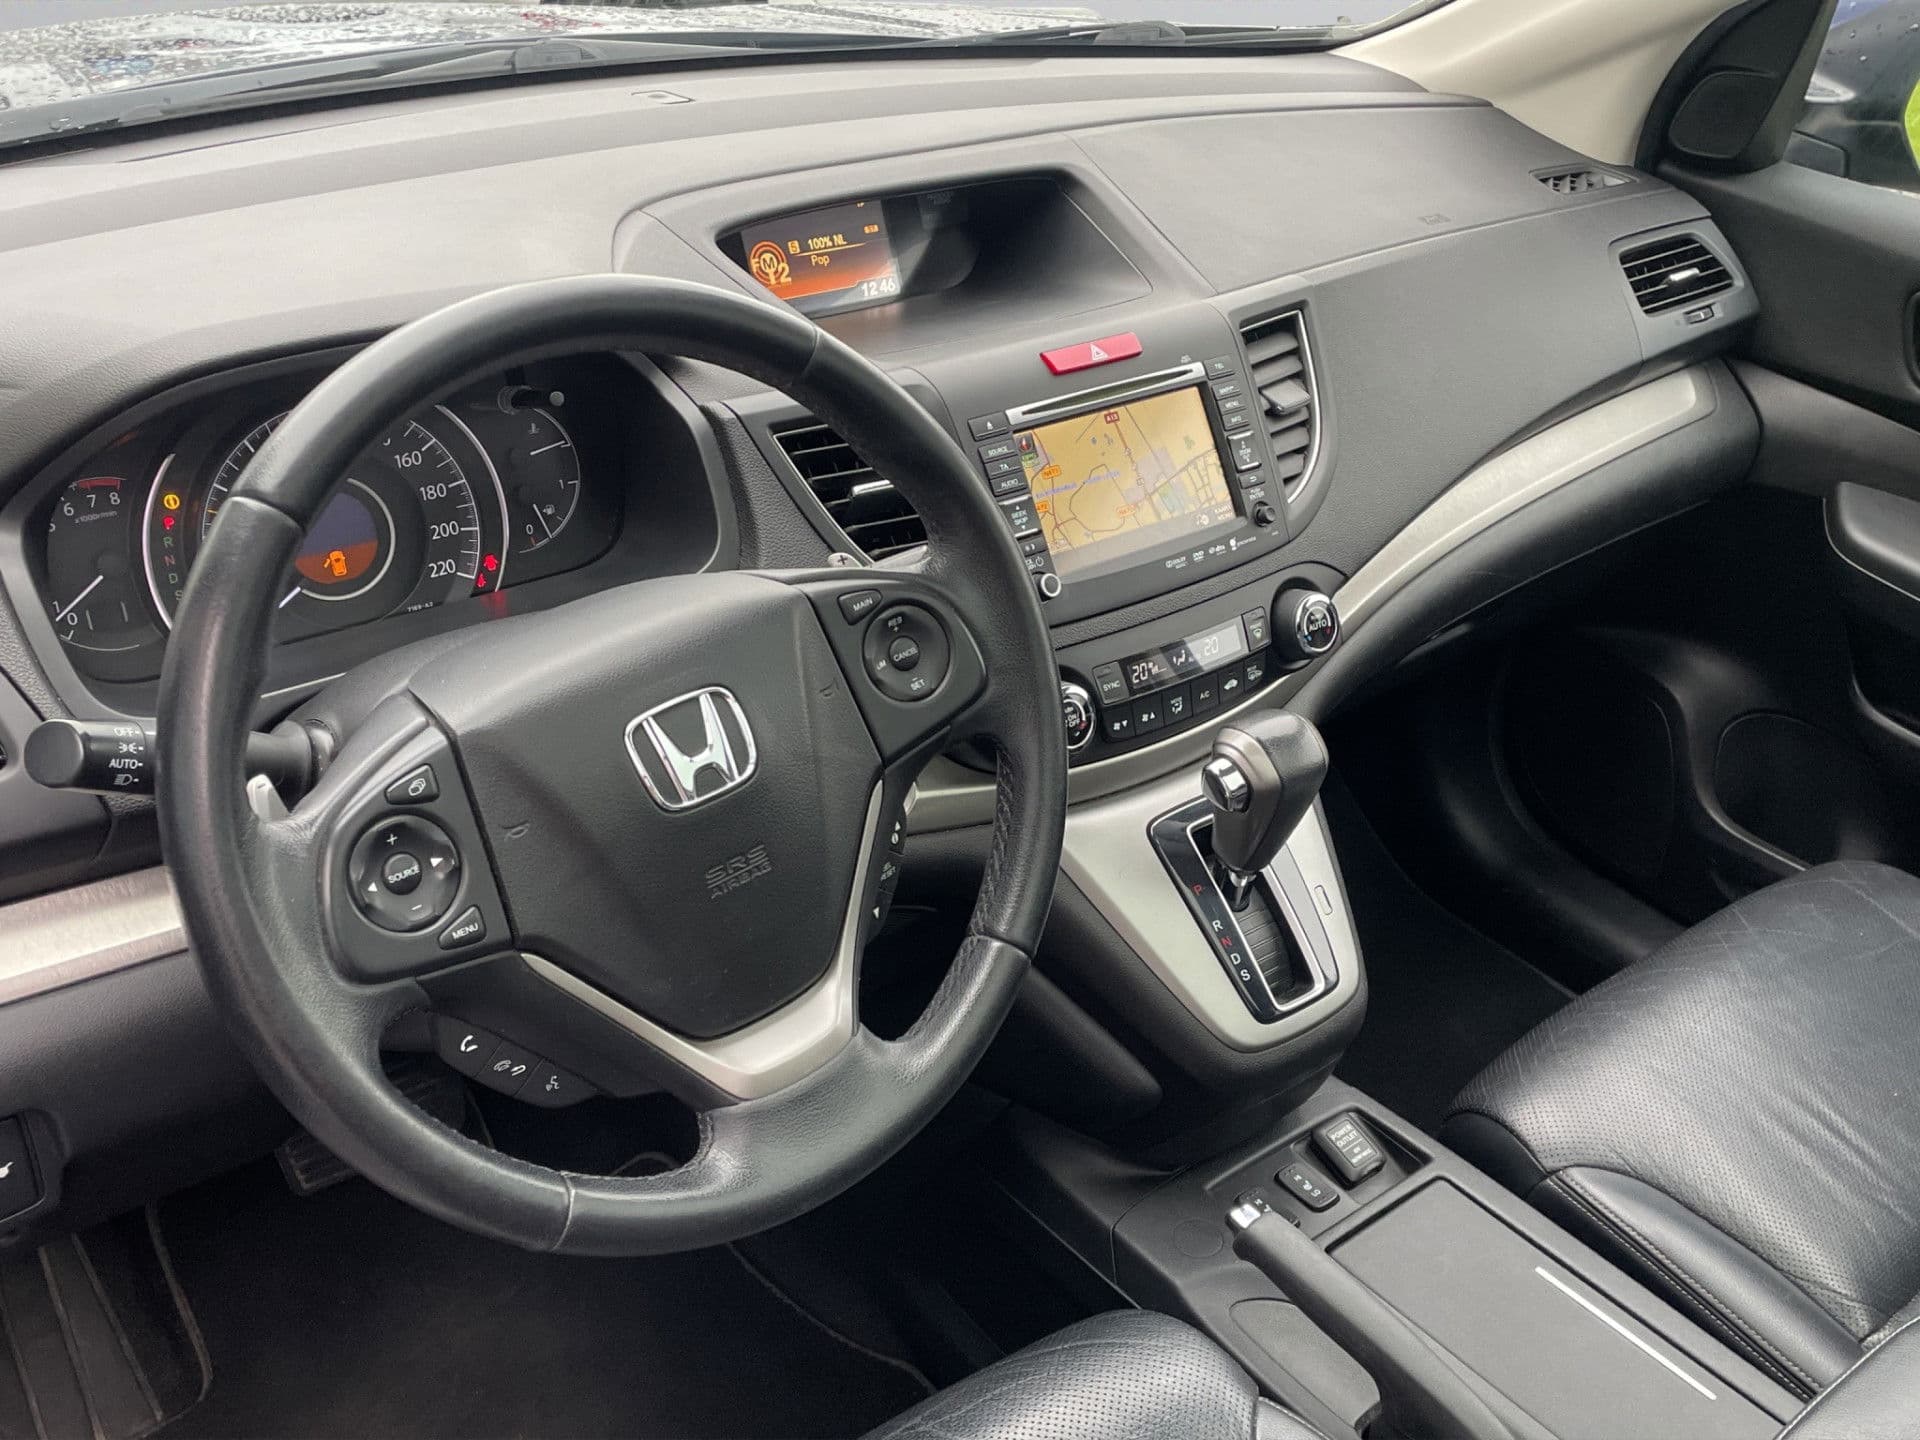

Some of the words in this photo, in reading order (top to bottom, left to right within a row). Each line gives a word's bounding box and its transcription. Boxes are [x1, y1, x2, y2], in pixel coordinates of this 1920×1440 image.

[808, 237, 832, 250] 100%
[811, 255, 830, 266] Pop
[394, 450, 422, 468] 160
[109, 491, 121, 505] 8
[420, 482, 447, 501] 180
[86, 494, 96, 508] 7
[63, 502, 74, 516] 6
[430, 519, 460, 540] 200
[525, 524, 534, 535] 0
[163, 536, 174, 548] R
[164, 554, 176, 567] N
[428, 558, 456, 578] 220
[168, 573, 178, 584] D
[853, 597, 873, 612] MAIN
[67, 612, 78, 625] 0
[1308, 619, 1328, 633] AUTO
[1204, 636, 1219, 656] 20
[1103, 679, 1121, 692] SYNC
[108, 758, 138, 770] AUTO
[387, 863, 421, 884] SOURCE
[1192, 883, 1203, 896] P
[451, 923, 479, 939] MENU
[1212, 920, 1224, 932] R
[1220, 936, 1233, 949] N
[1230, 953, 1241, 965] D
[1240, 969, 1251, 981] S
